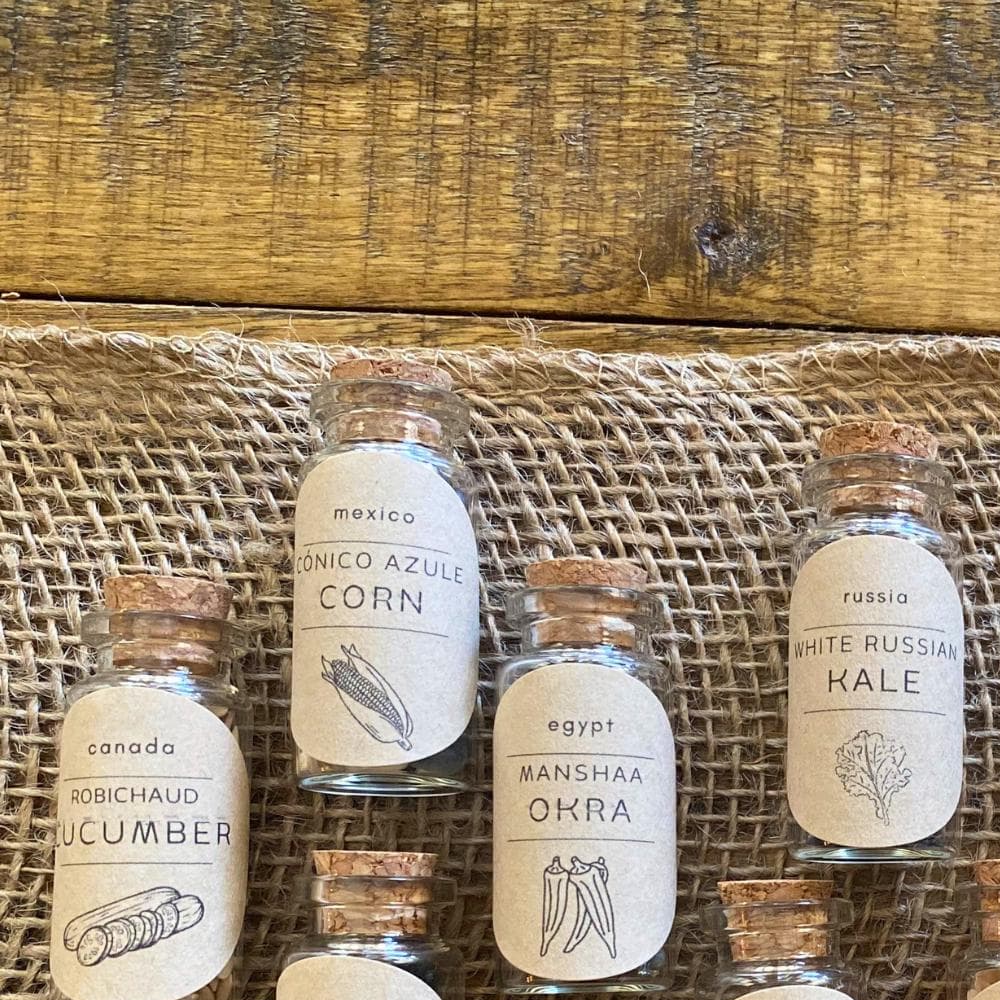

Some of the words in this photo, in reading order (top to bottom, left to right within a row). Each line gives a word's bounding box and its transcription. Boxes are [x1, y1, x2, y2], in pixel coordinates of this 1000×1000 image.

[334, 507, 415, 524] mexico
[385, 555, 463, 584] AZULE
[320, 584, 422, 614] CORN
[843, 590, 908, 604] russia
[794, 635, 852, 659] WHITE
[865, 635, 957, 661] RUSSIAN
[828, 668, 920, 694] KALE
[548, 718, 614, 737] egypt
[87, 738, 175, 755] canada
[519, 764, 643, 783] MANSHAA
[71, 787, 198, 804] ROBICHAUD
[529, 798, 631, 822] OKRA
